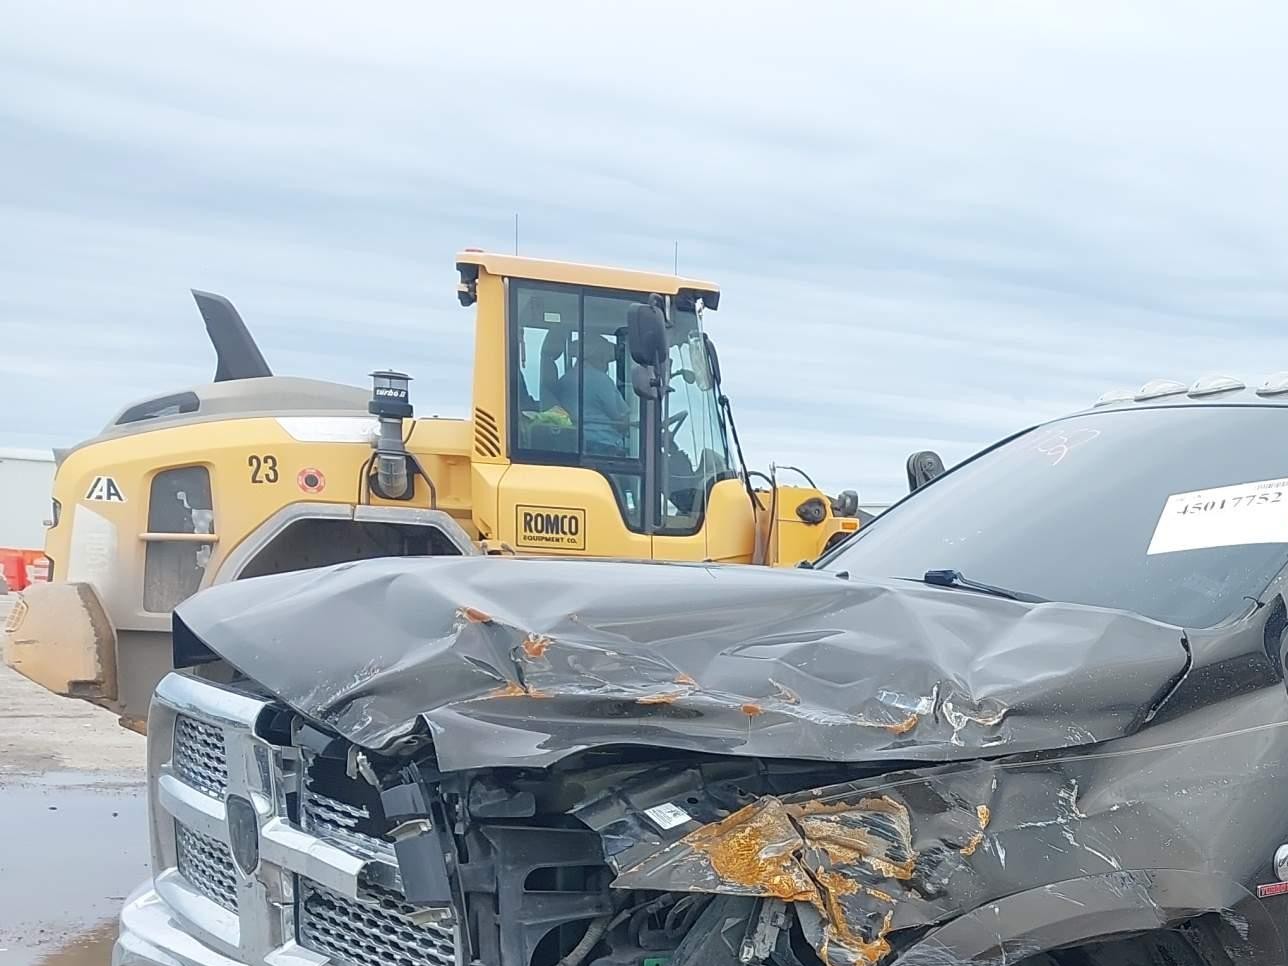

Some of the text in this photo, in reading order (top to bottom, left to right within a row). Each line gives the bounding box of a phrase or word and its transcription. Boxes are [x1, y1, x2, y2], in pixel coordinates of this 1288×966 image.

[248, 455, 279, 483] 23
[1177, 491, 1283, 515] 45017752
[523, 511, 579, 536] ROMCO
[523, 535, 564, 543] EQUIPMENT
